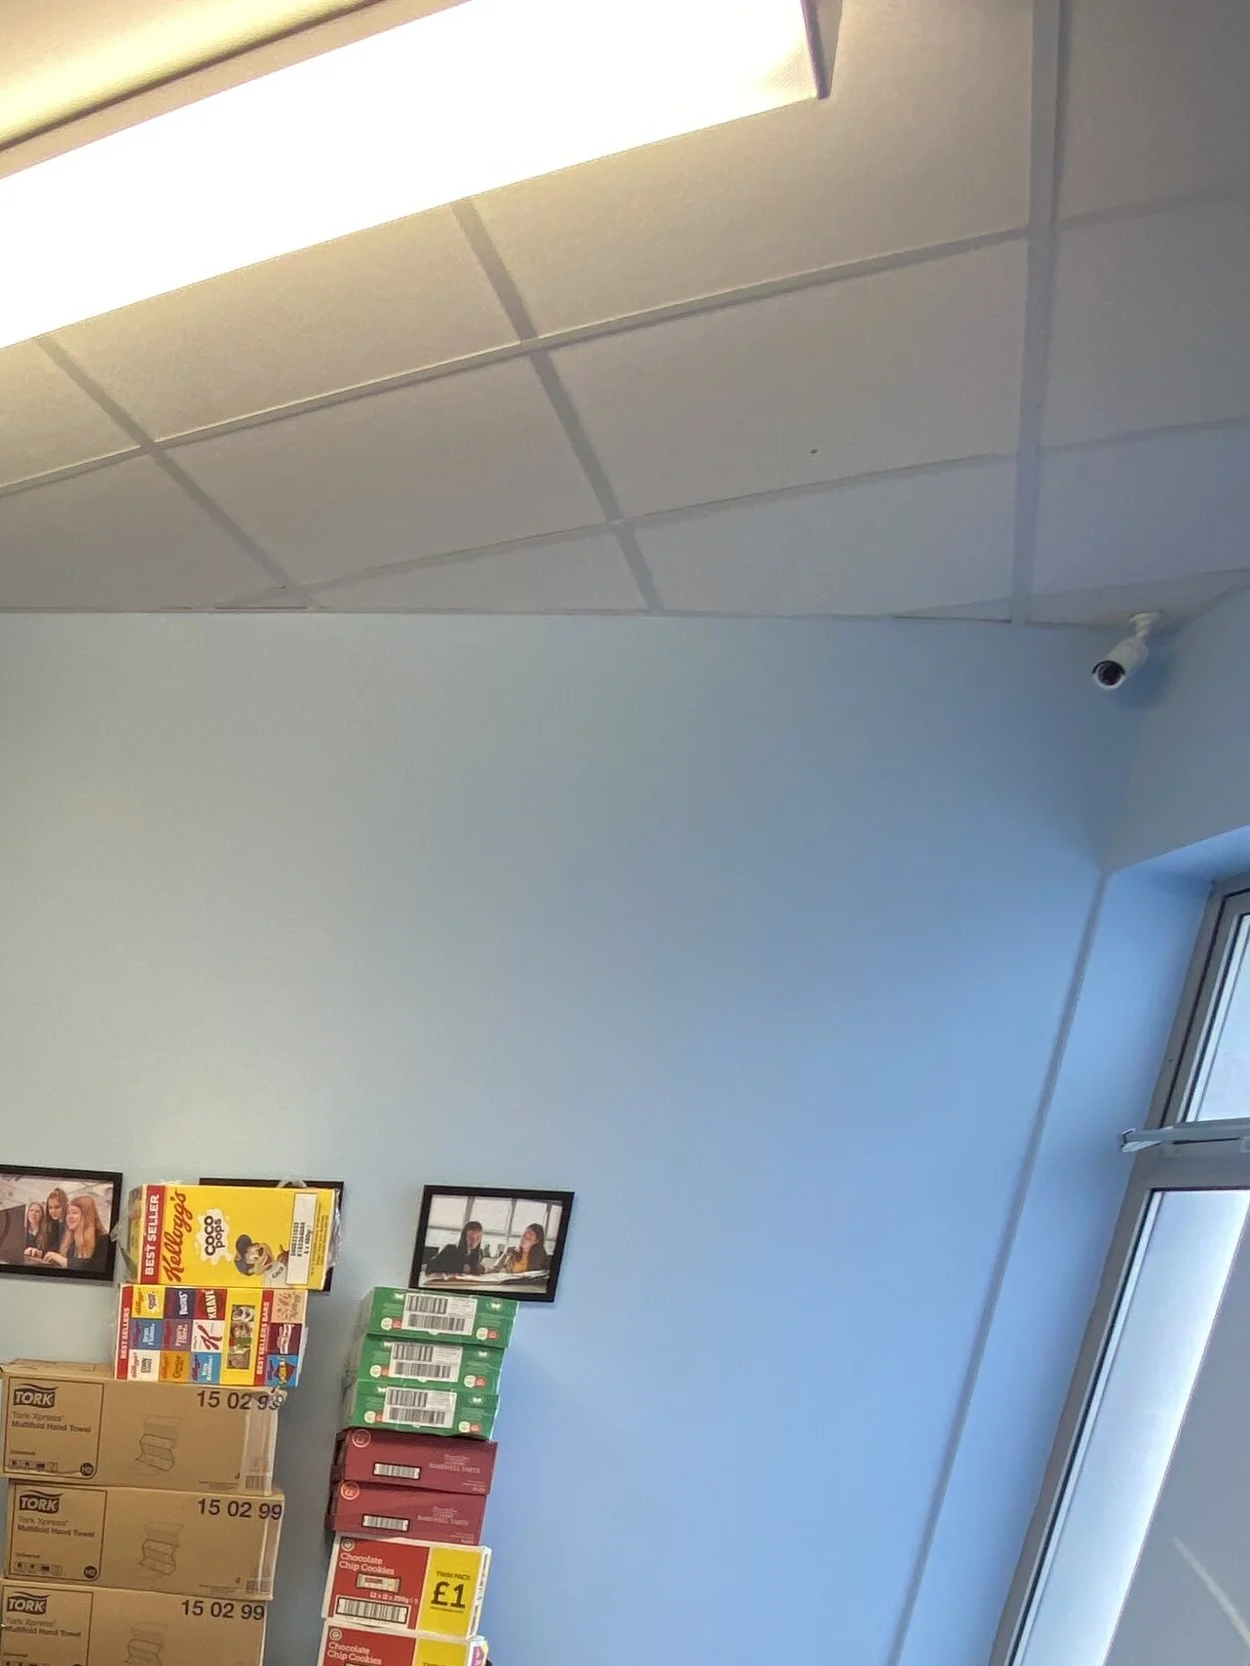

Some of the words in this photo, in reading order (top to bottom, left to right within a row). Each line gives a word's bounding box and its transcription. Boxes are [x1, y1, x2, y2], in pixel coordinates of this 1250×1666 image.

[146, 1194, 160, 1243] SELLER
[162, 1190, 193, 1283] Kellogg's
[204, 1215, 216, 1257] COCO
[214, 1218, 225, 1250] pops
[145, 1245, 157, 1276] BEST
[204, 1289, 217, 1320] KRAVE
[15, 1391, 54, 1406] TORK
[197, 1391, 220, 1407] 15
[227, 1392, 250, 1409] 02
[12, 1420, 45, 1430] Multifold
[47, 1423, 67, 1432] Hand
[69, 1425, 91, 1433] Towel
[20, 1498, 59, 1512] TORK
[198, 1498, 220, 1515] 15
[227, 1500, 252, 1517] 02
[259, 1503, 283, 1520] 99
[17, 1524, 50, 1534] Multifold
[52, 1527, 71, 1536] Hand
[73, 1530, 95, 1538] Towel
[340, 1552, 383, 1564] Chocolate
[339, 1561, 359, 1572] Chip
[361, 1564, 395, 1575] Cookies
[435, 1571, 453, 1580] TWIN
[453, 1573, 471, 1581] PACK
[430, 1581, 465, 1609] £1
[9, 1599, 46, 1614] TORK
[182, 1600, 204, 1616] 15
[211, 1602, 234, 1619] 02
[241, 1604, 265, 1621] 99
[6, 1625, 37, 1635] Multifold
[39, 1628, 58, 1637] Hand
[60, 1630, 82, 1638] Towel
[328, 1641, 370, 1654] Chocolate
[327, 1649, 347, 1661] Chip
[349, 1653, 382, 1665] Cookies
